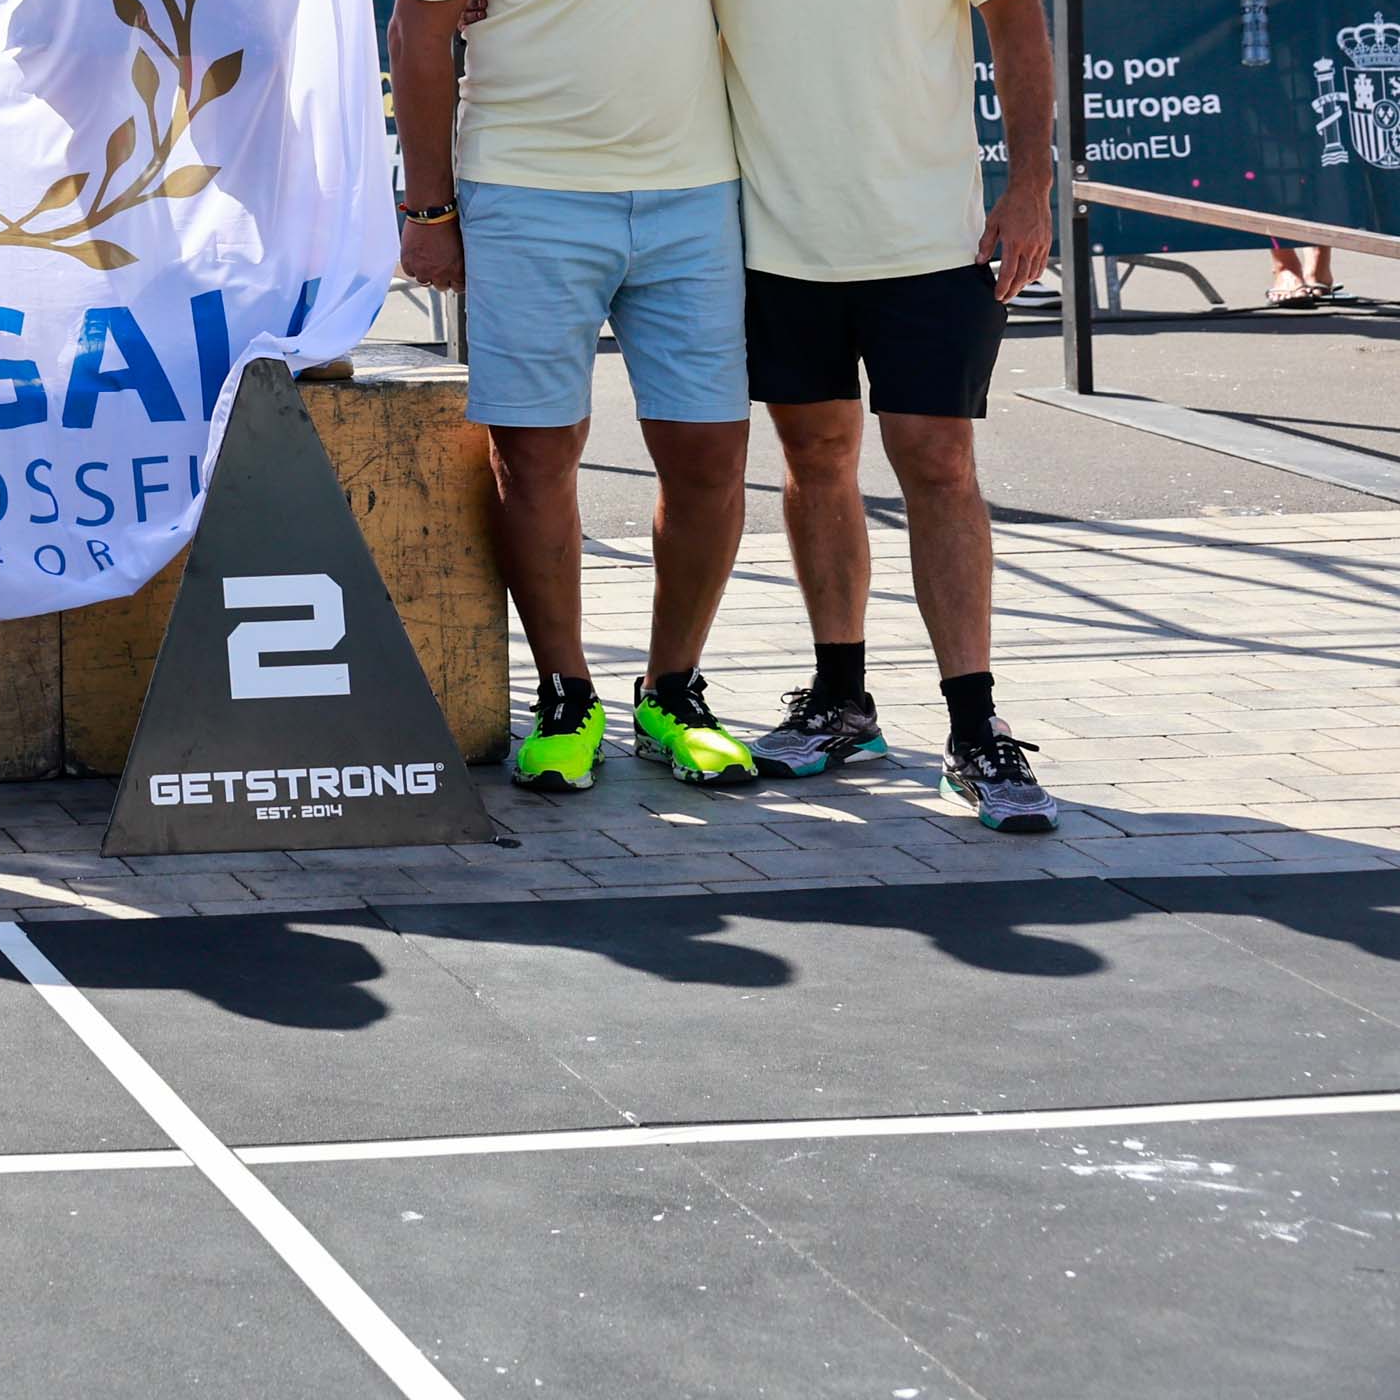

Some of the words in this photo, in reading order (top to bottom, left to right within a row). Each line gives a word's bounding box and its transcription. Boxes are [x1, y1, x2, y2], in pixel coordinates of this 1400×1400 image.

[1124, 57, 1180, 85] por
[1083, 93, 1222, 123] Europea
[222, 573, 351, 700] 2
[150, 762, 438, 806] GETSTRONG
[256, 805, 297, 821] EST.
[301, 804, 343, 819] 2014
